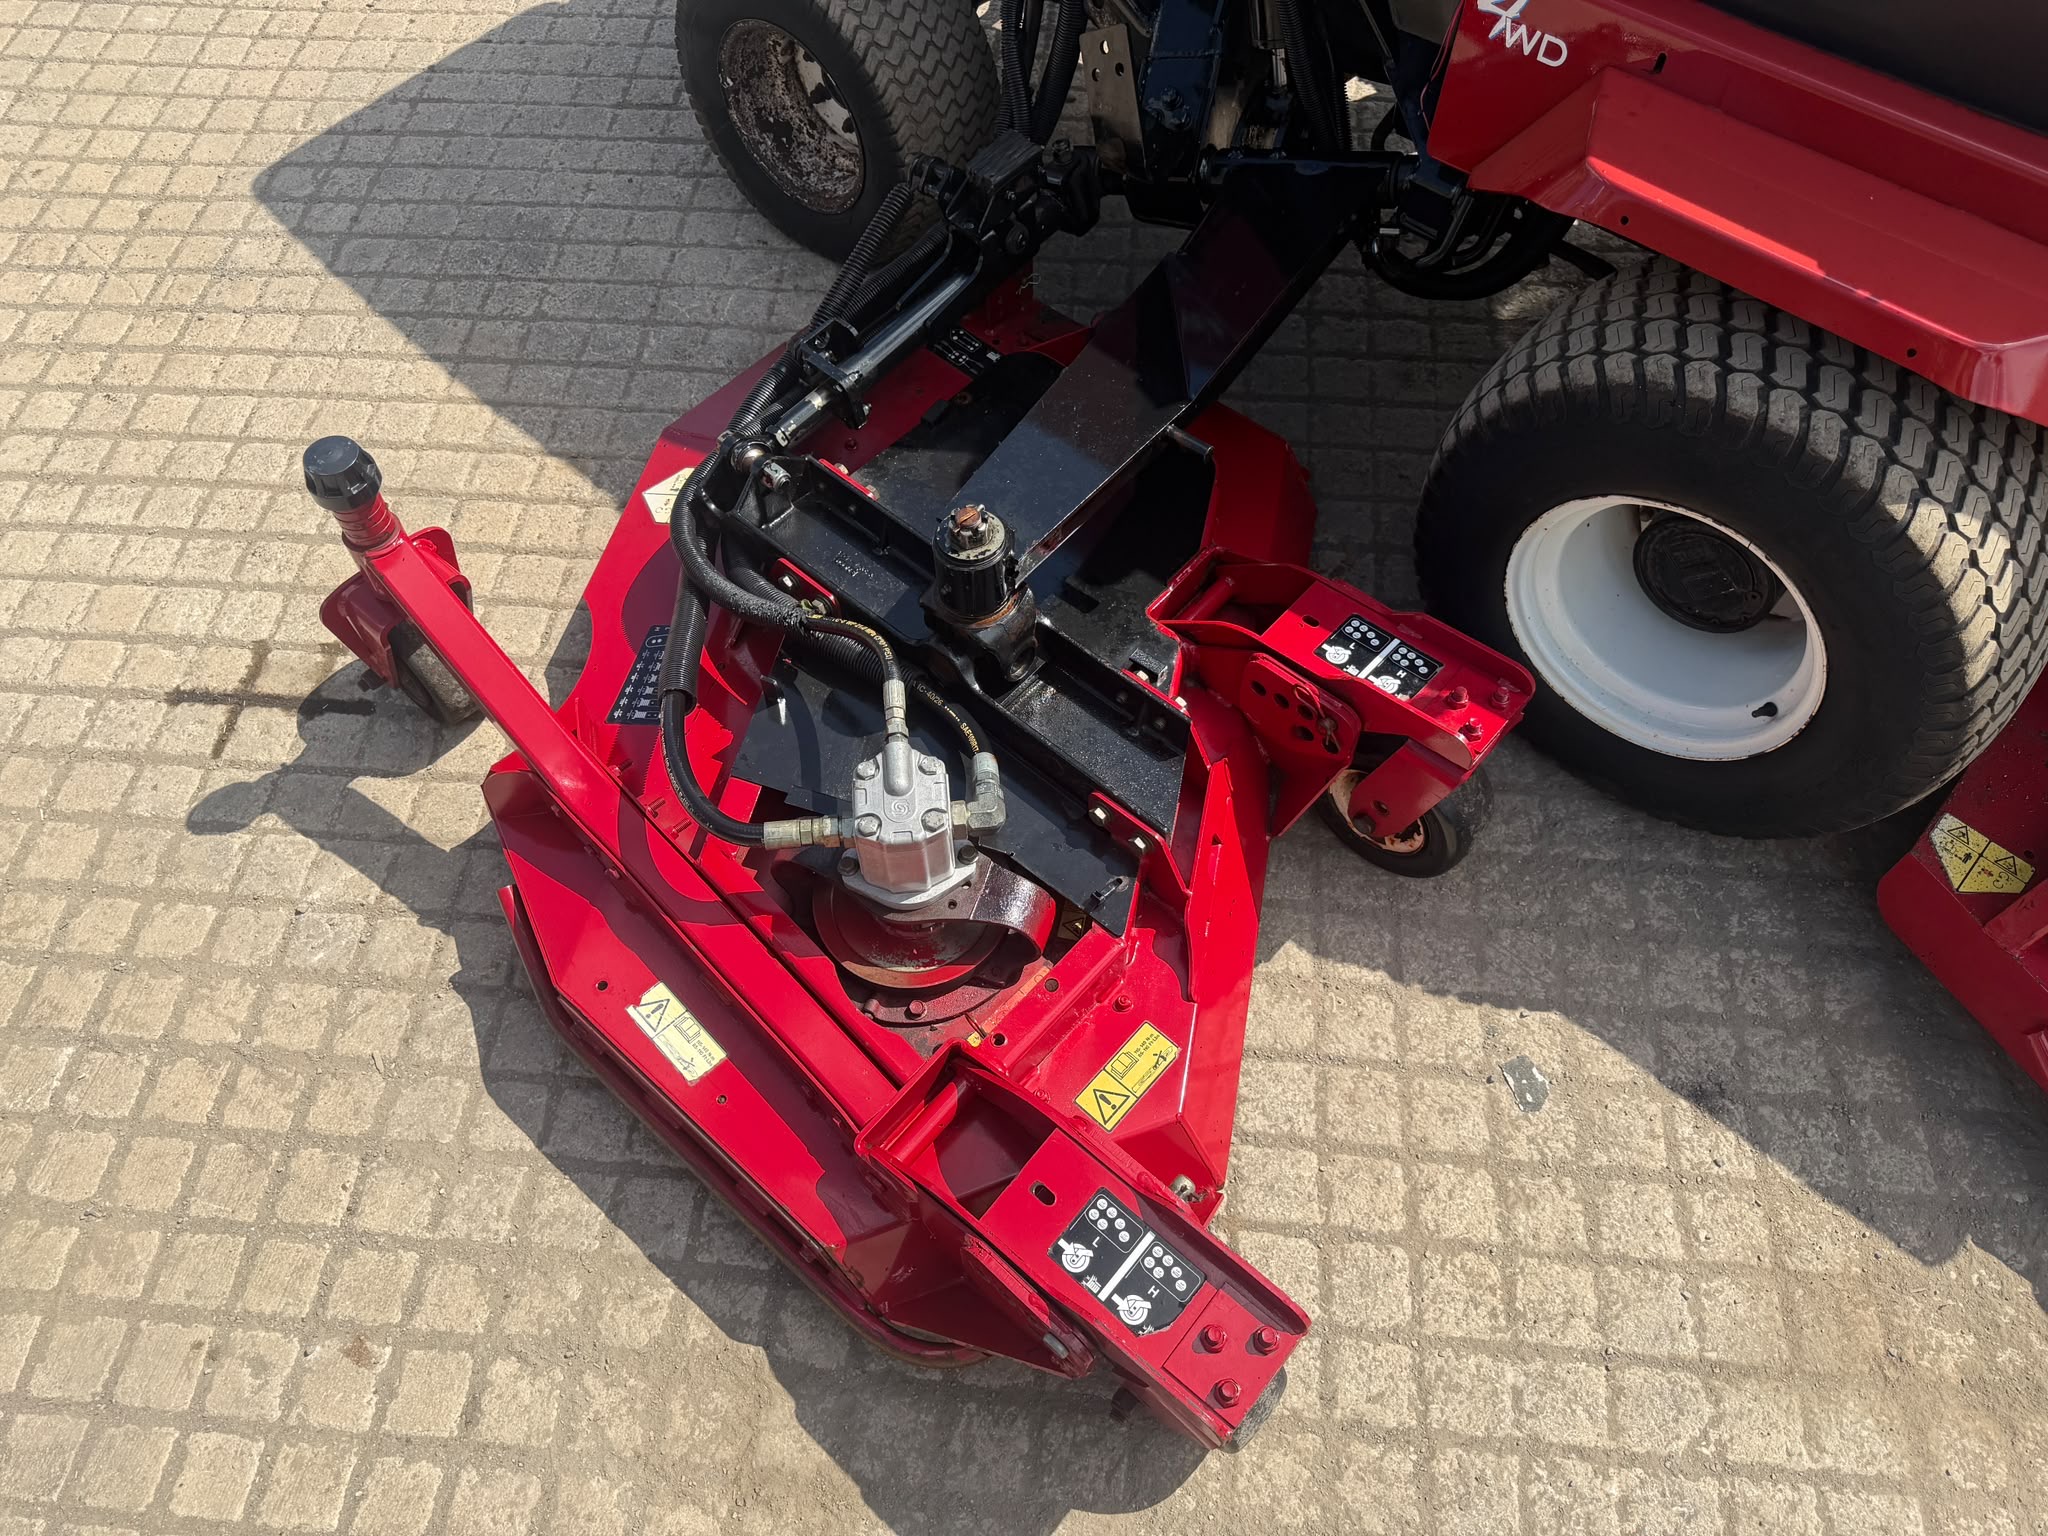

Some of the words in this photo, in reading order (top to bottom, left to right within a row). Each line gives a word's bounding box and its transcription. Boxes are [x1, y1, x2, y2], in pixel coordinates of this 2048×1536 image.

[1396, 669, 1407, 678] H
[1092, 1236, 1100, 1248] L
[1147, 1285, 1160, 1298] H
